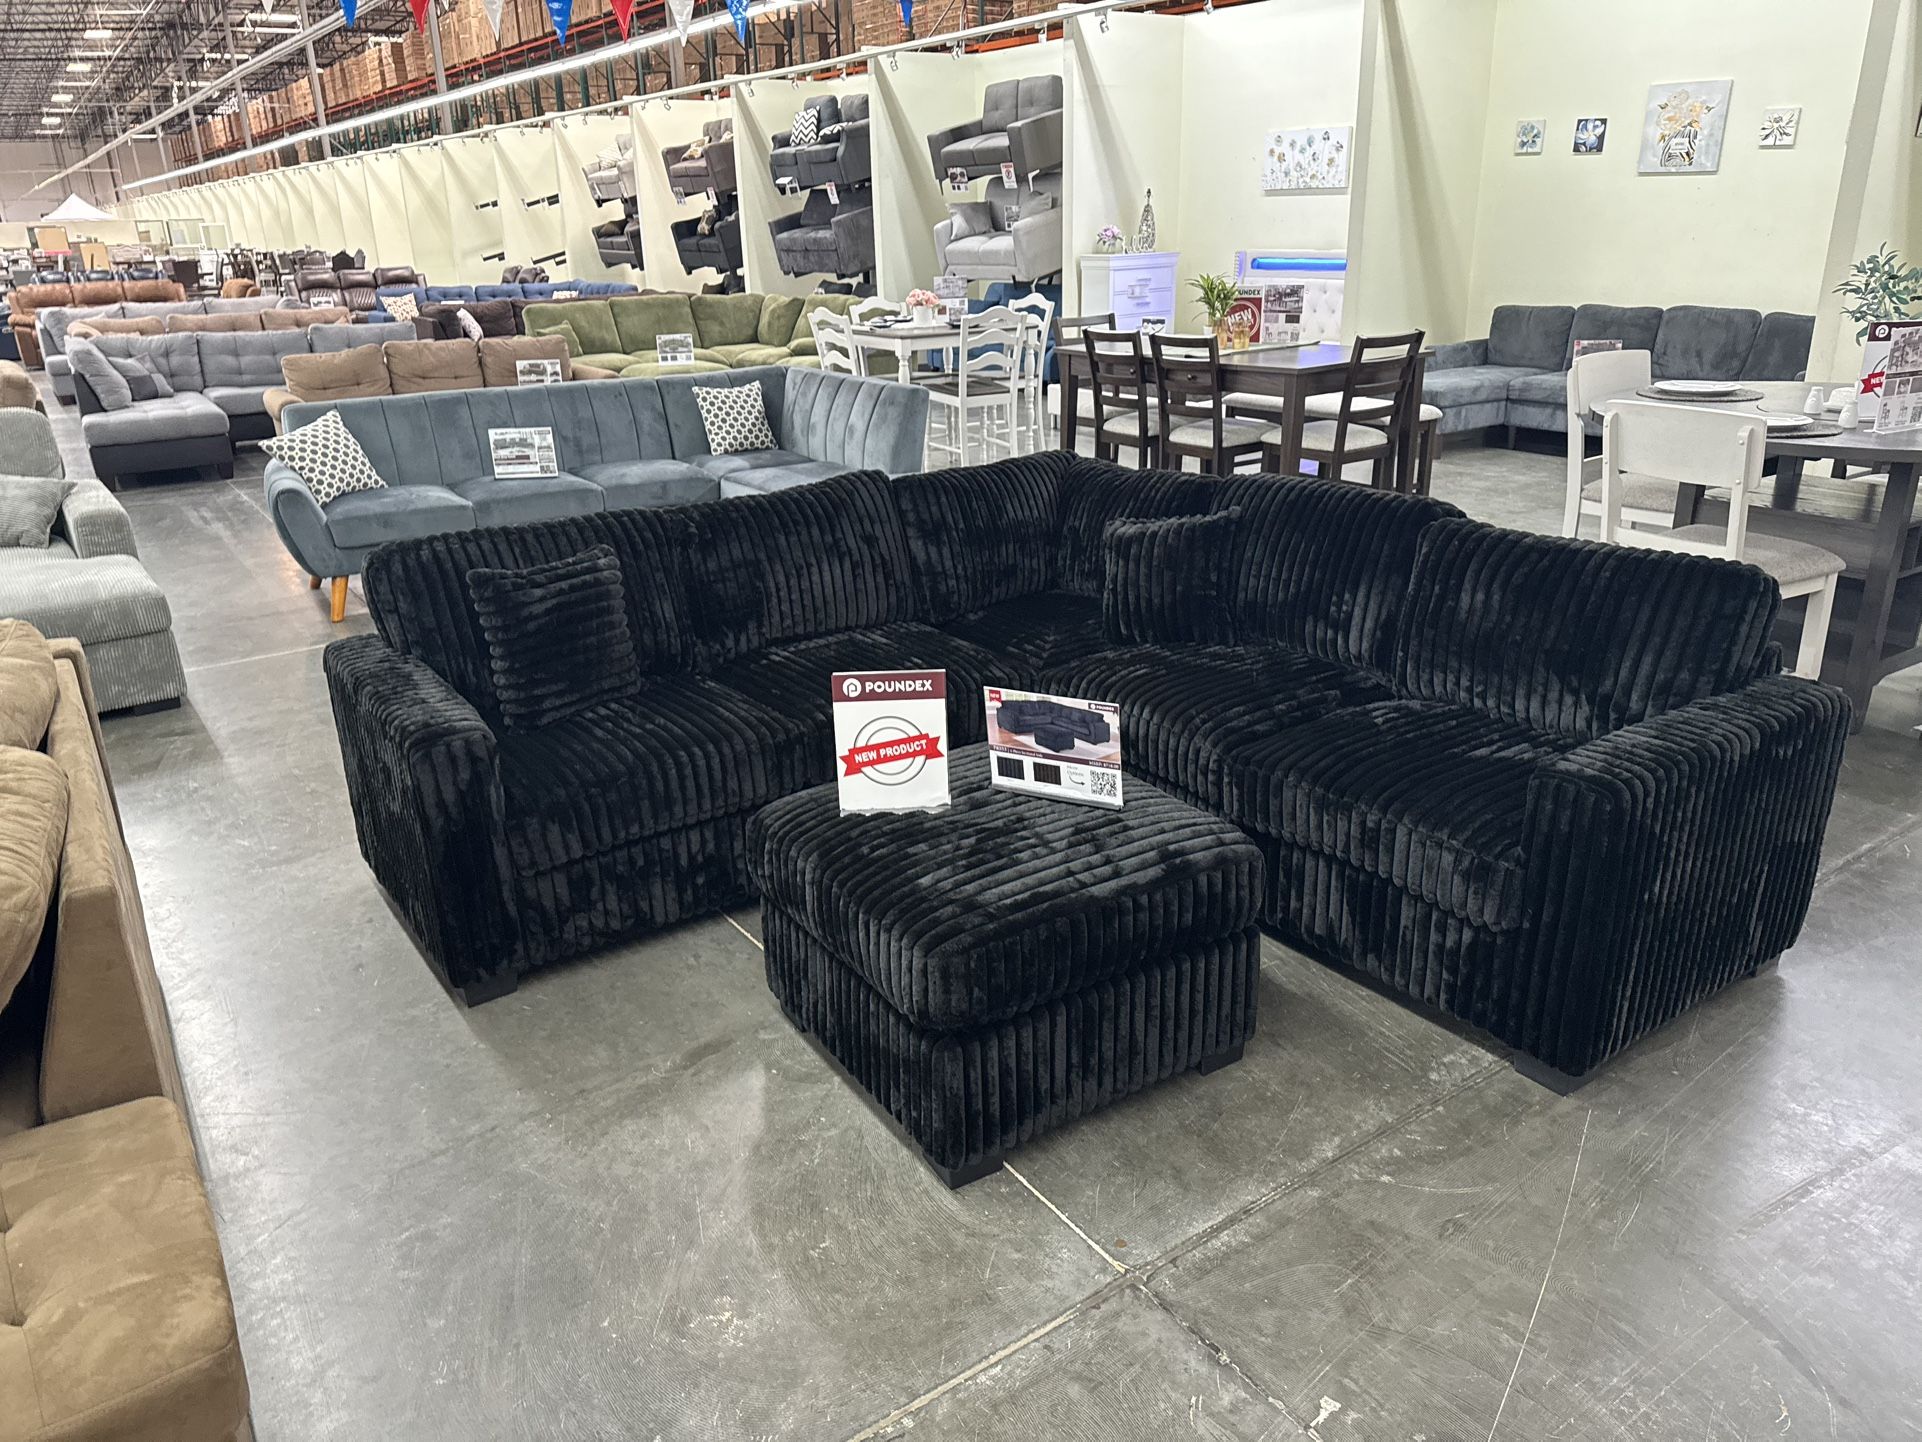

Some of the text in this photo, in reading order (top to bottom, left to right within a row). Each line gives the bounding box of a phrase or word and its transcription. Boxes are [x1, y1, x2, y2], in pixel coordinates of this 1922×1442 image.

[1228, 308, 1253, 325] NEW
[865, 680, 933, 692] POUNDEX
[854, 740, 928, 764] NEW PRODUCT
